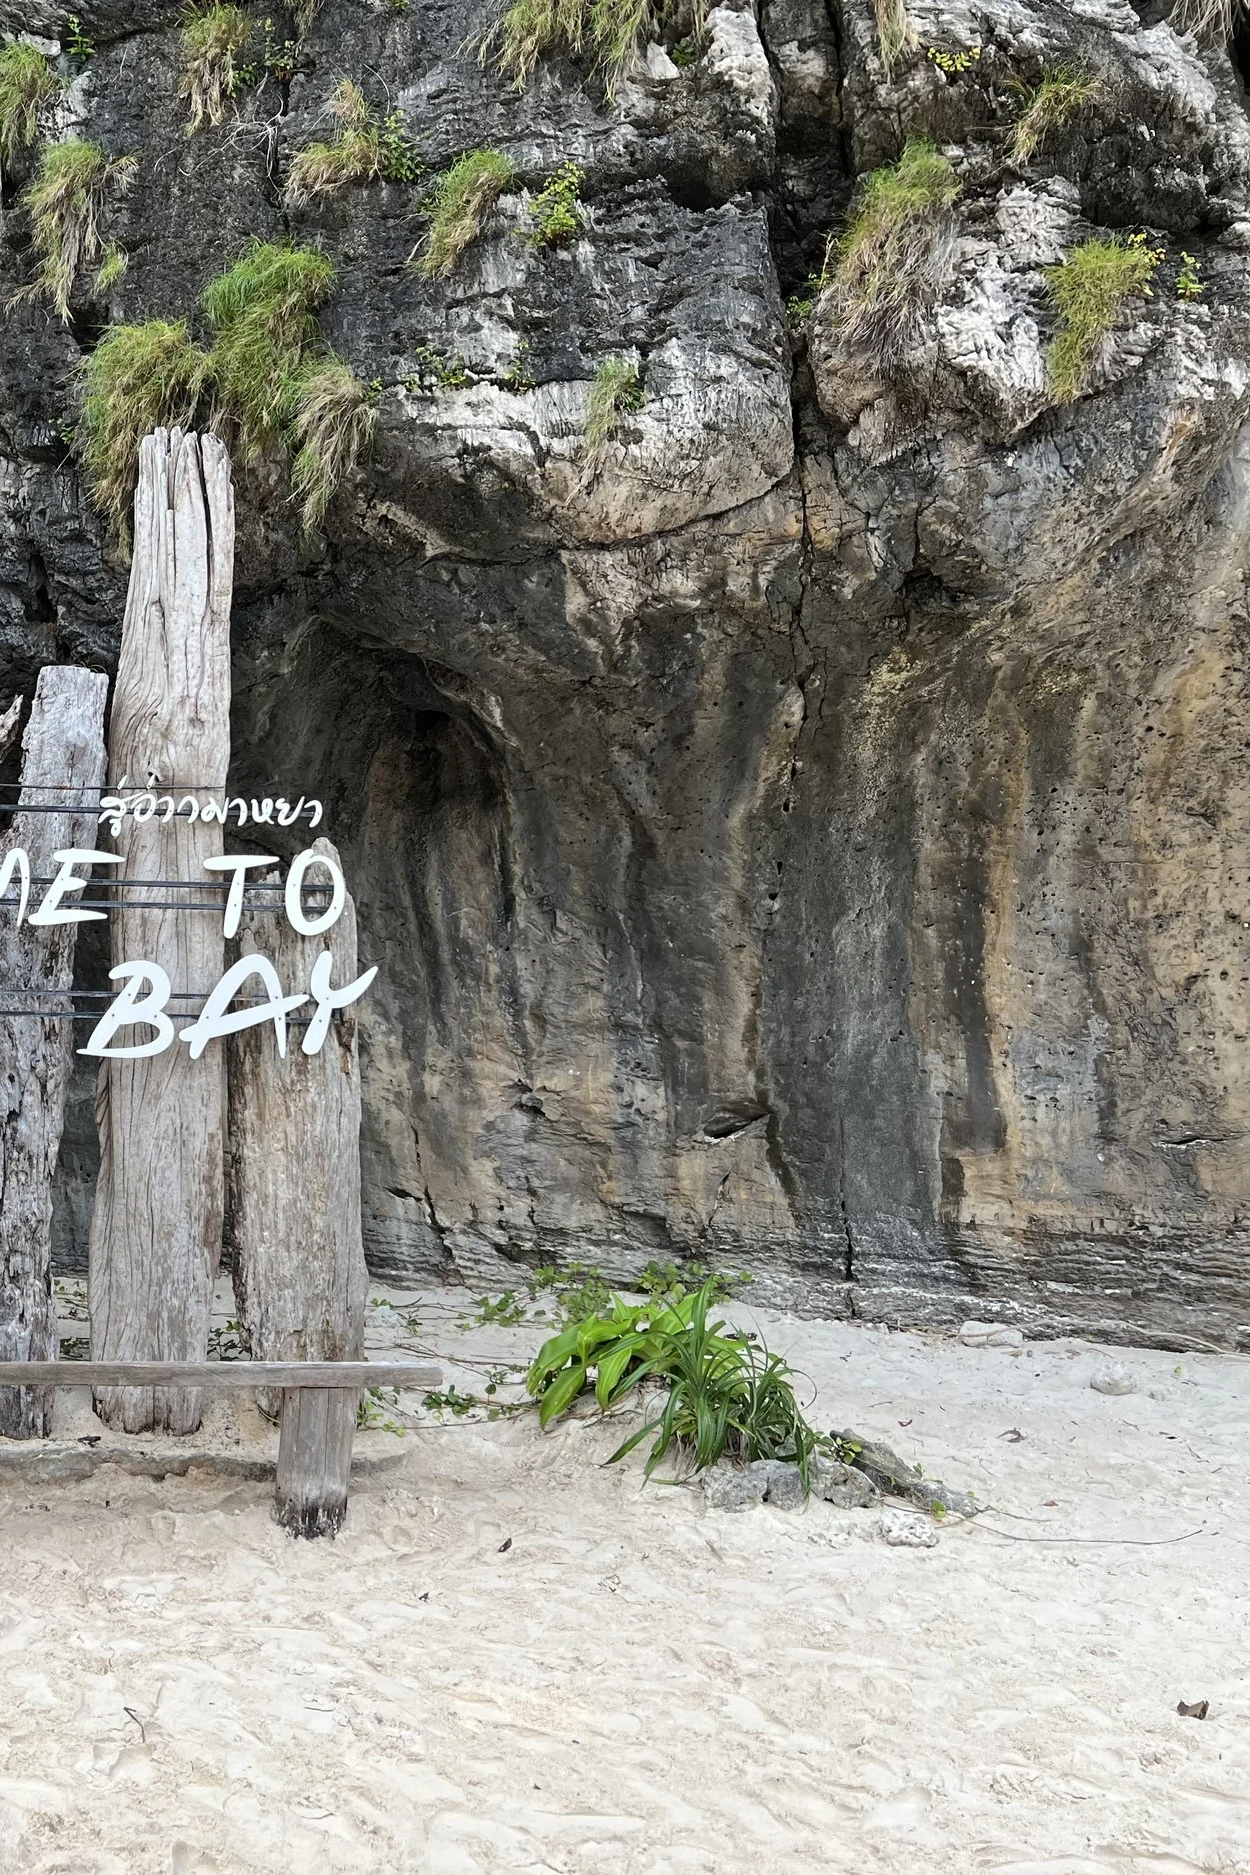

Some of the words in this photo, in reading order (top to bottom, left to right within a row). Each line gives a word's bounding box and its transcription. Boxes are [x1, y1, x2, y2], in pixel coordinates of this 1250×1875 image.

[98, 773, 324, 837] สู่อ่าวมาหยา
[202, 848, 347, 939] TO
[76, 950, 379, 1060] BAY
